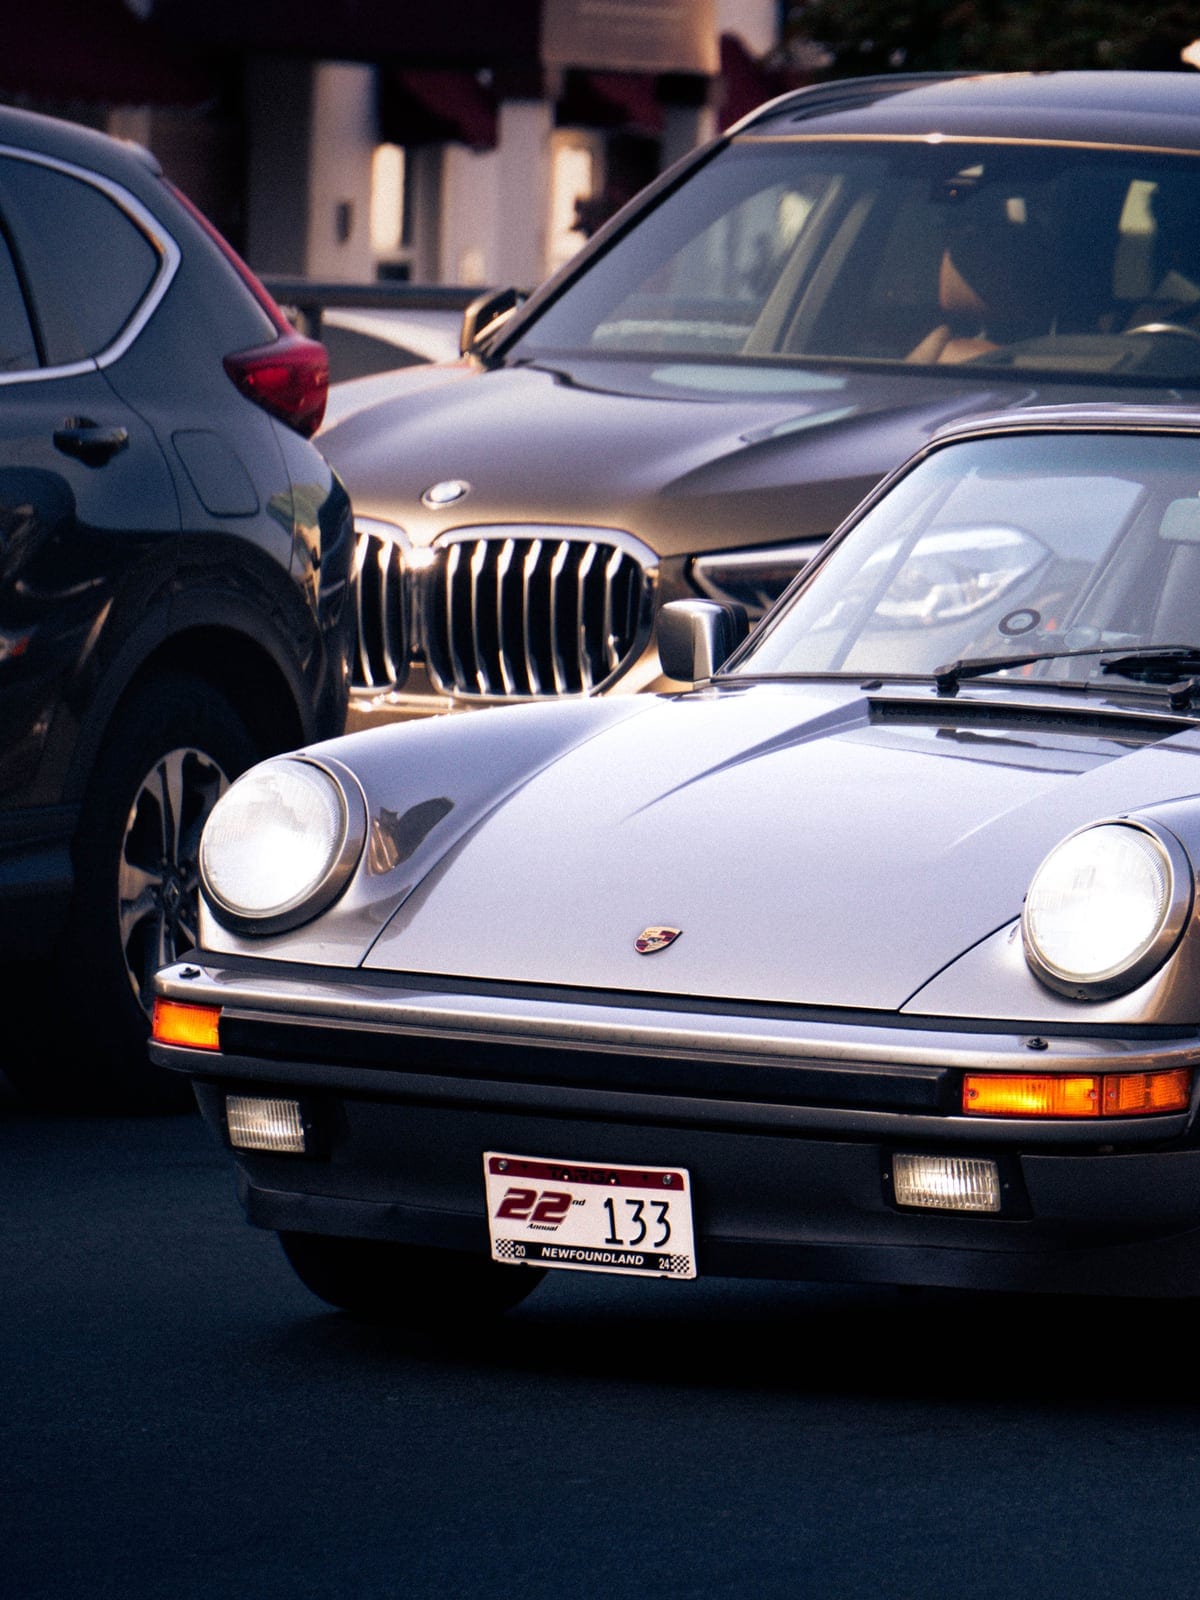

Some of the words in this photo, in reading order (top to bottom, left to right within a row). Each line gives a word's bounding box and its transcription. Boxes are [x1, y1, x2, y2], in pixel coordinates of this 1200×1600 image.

[548, 1165, 620, 1185] TARGA
[527, 1222, 559, 1232] Annual
[604, 1198, 671, 1248] 133
[514, 1244, 526, 1257] 20
[541, 1247, 644, 1266] NEWFOUNDLAND
[658, 1257, 671, 1270] 24
